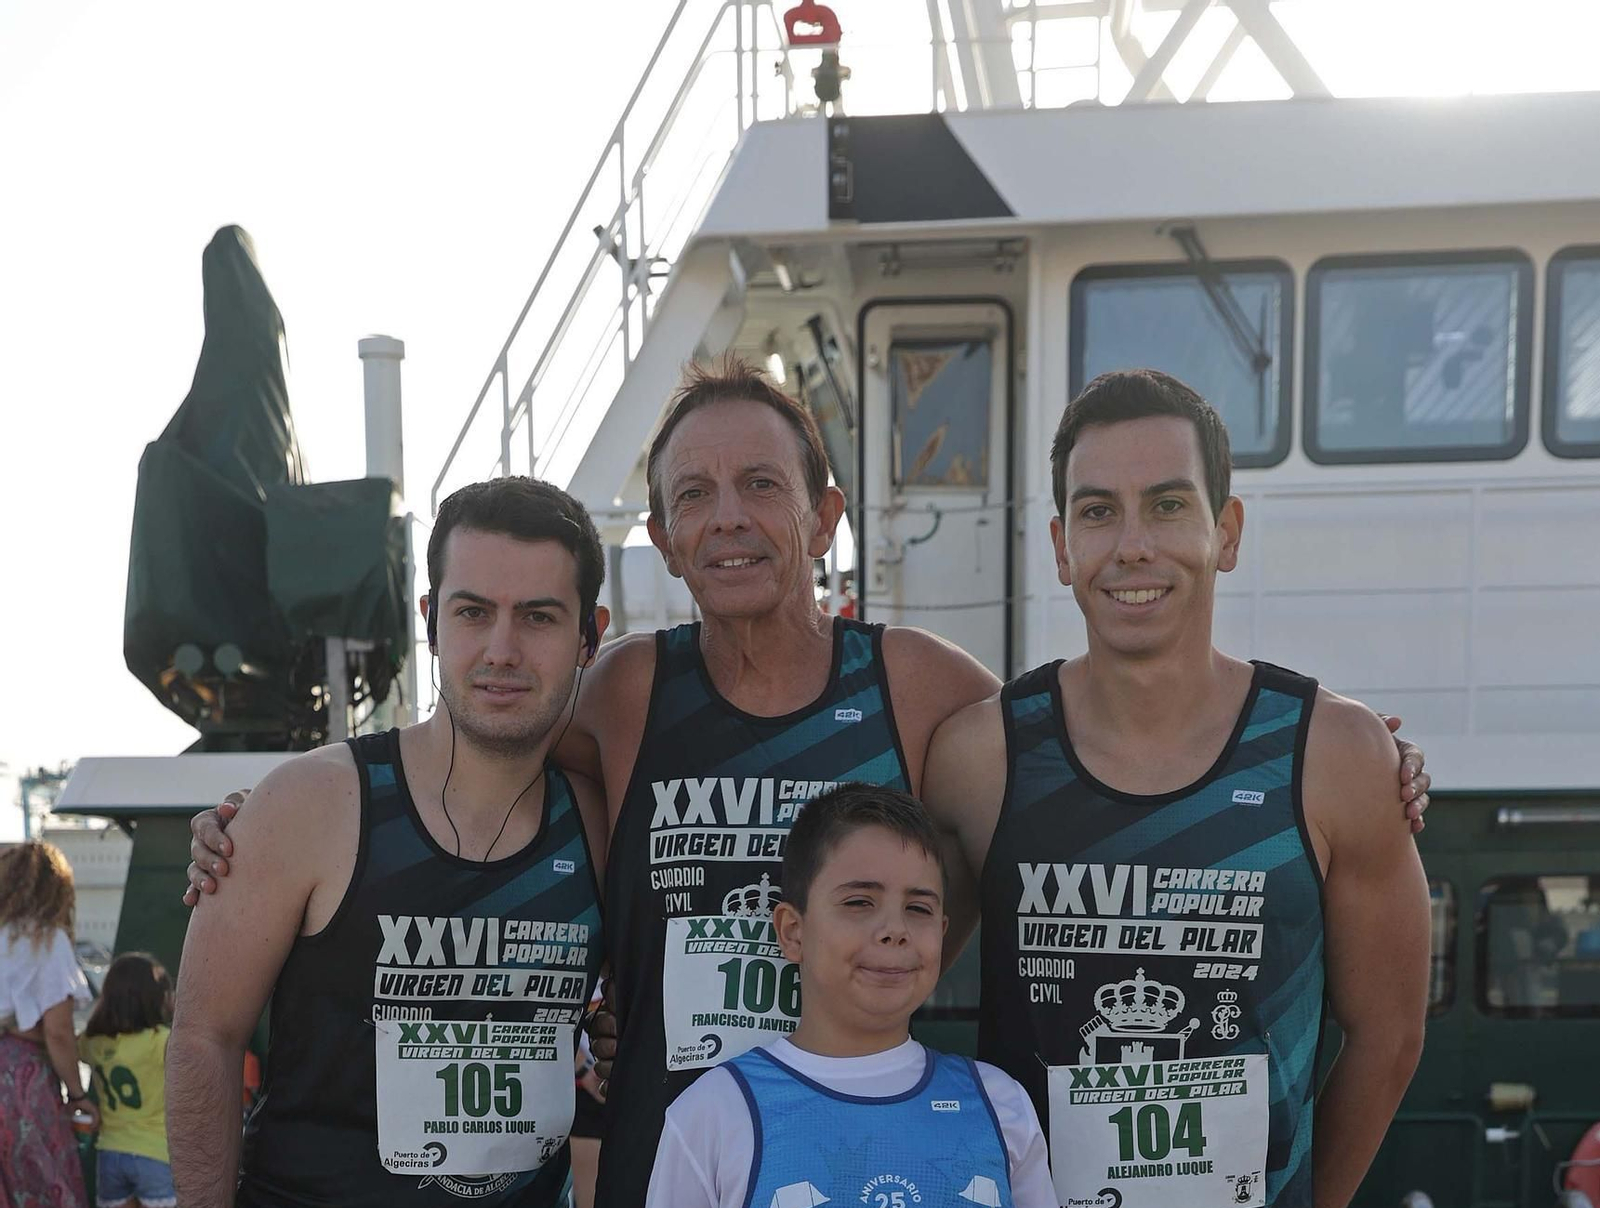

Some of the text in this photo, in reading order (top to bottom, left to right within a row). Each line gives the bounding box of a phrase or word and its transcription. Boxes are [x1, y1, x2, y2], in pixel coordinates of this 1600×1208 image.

[650, 777, 774, 828] XXVI
[654, 833, 736, 859] VIRGEN
[650, 866, 705, 891] GUARDIA
[1017, 862, 1149, 916] XXVI
[1153, 867, 1266, 893] CARRERA
[665, 892, 693, 913] CIVIL
[1151, 892, 1266, 918] POPULAR
[376, 914, 499, 966] XXVI
[503, 919, 589, 944] CARRERA
[686, 919, 777, 943] XXVI
[1022, 923, 1257, 955] VIRGEN DEL PILAR
[502, 943, 588, 967] POPULAR
[688, 941, 749, 953] VIRGEN
[1018, 957, 1075, 979] GUARDIA
[1193, 963, 1260, 981] 2024
[379, 973, 582, 1000] VIRGEN DEL PILAR
[717, 957, 802, 1017] 106
[1029, 983, 1062, 1004] CIVIL
[398, 1023, 488, 1044] XXVI
[491, 1025, 557, 1035] CARRERA
[692, 1013, 797, 1033] FRANCISCO JAVIER
[491, 1035, 557, 1044] POPULAR
[697, 1043, 705, 1051] de
[402, 1046, 555, 1060] VIRGEN DEL PILAR
[670, 1053, 704, 1064] Algeciras
[1068, 1063, 1164, 1089] XXVI
[1167, 1058, 1246, 1073] CARRERA
[1167, 1068, 1245, 1083] POPULAR
[435, 1062, 522, 1118] 105
[1073, 1082, 1244, 1104] VIRGEN DEL PILAR
[424, 1121, 536, 1134] PABLO CARLOS LUQUE
[1108, 1102, 1207, 1161] 104
[384, 1158, 429, 1168] Algeciras
[393, 1150, 430, 1159] Puerto de
[1107, 1160, 1213, 1179] ALEJANDRO LUQUE
[860, 1174, 921, 1204] ANIVERSARIO
